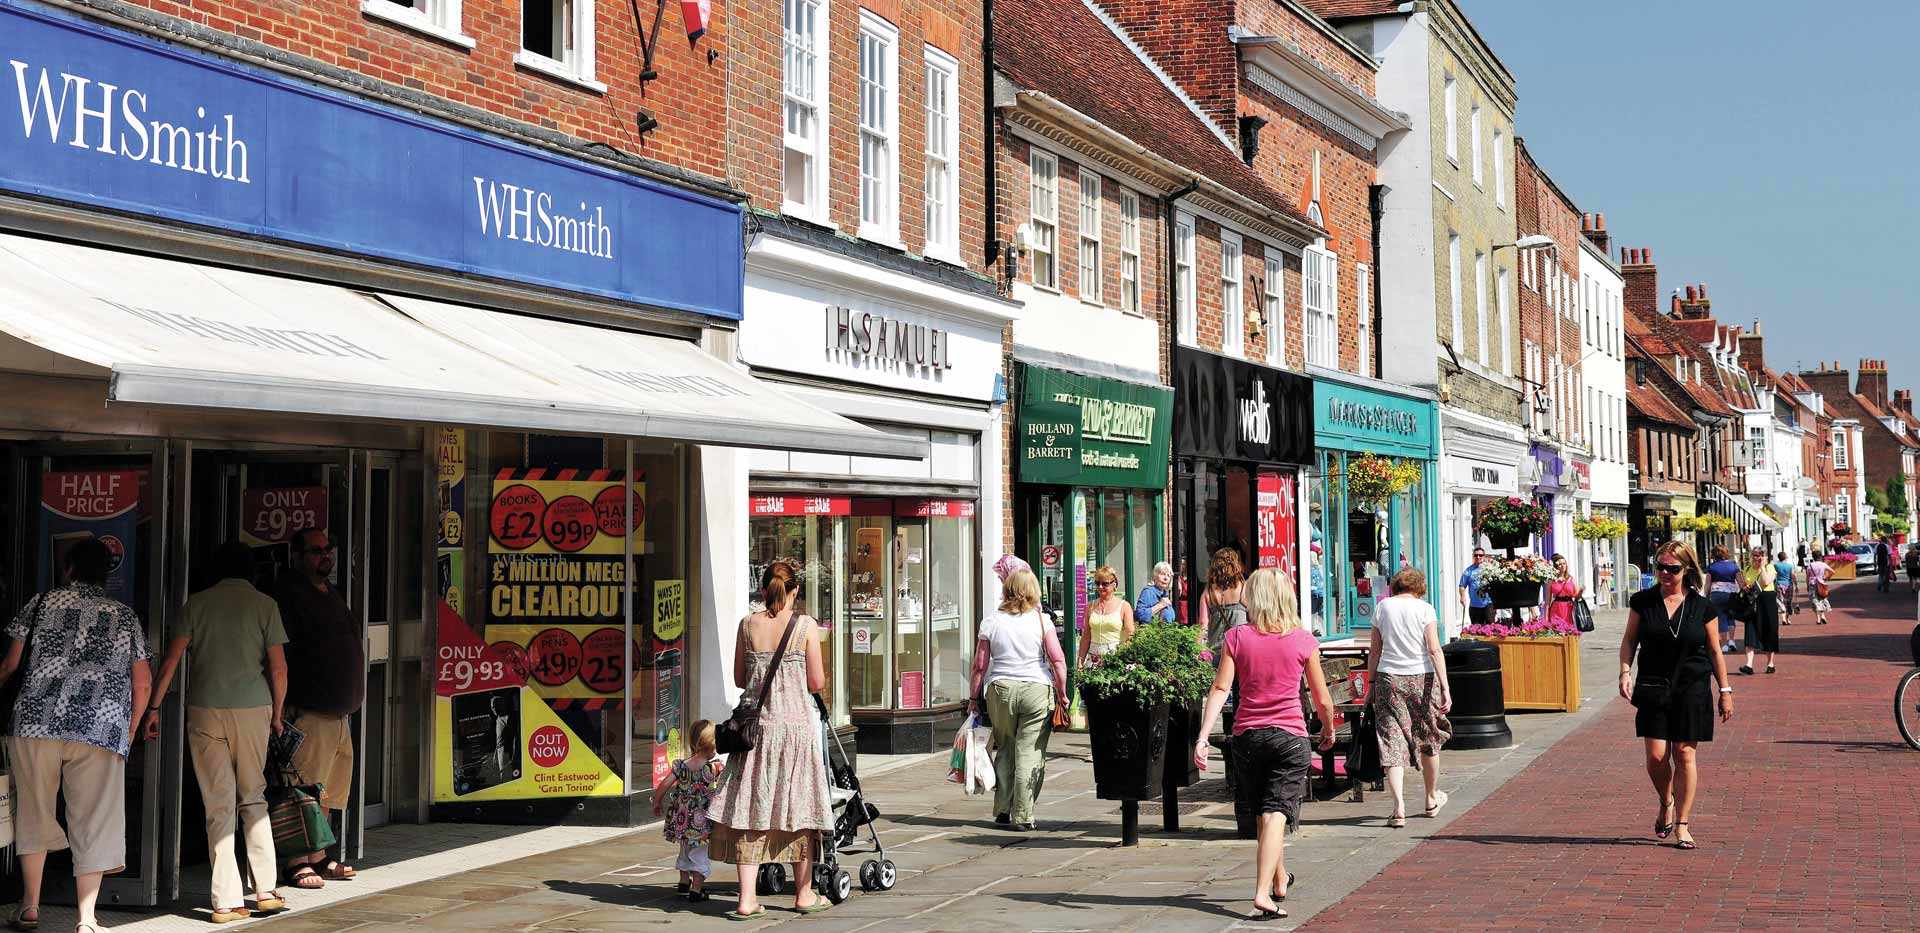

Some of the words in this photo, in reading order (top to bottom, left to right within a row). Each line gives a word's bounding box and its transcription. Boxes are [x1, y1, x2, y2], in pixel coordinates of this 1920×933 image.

[10, 60, 251, 184] WHSmith
[473, 176, 613, 260] WHSmith
[1028, 423, 1074, 436] HOLLAND
[1045, 434, 1056, 446] &
[1028, 447, 1073, 459] BARRETT
[60, 474, 121, 497] HALF
[66, 497, 114, 514] PRICE
[262, 490, 310, 507] ONLY
[500, 494, 538, 506] BOOKS
[500, 511, 537, 540] £2
[551, 520, 594, 544] 99p
[509, 561, 581, 582] MILLION
[657, 586, 673, 600] WAYS
[673, 584, 682, 595] TO
[491, 584, 640, 618] CLEAROUT
[658, 596, 681, 622] SAVE
[541, 638, 569, 648] PENS
[439, 646, 485, 660] ONLY
[535, 652, 578, 675] 49p
[534, 734, 564, 745] OUT
[532, 747, 566, 758] NOW
[534, 773, 555, 782] Clint
[557, 772, 600, 781] Eastwood
